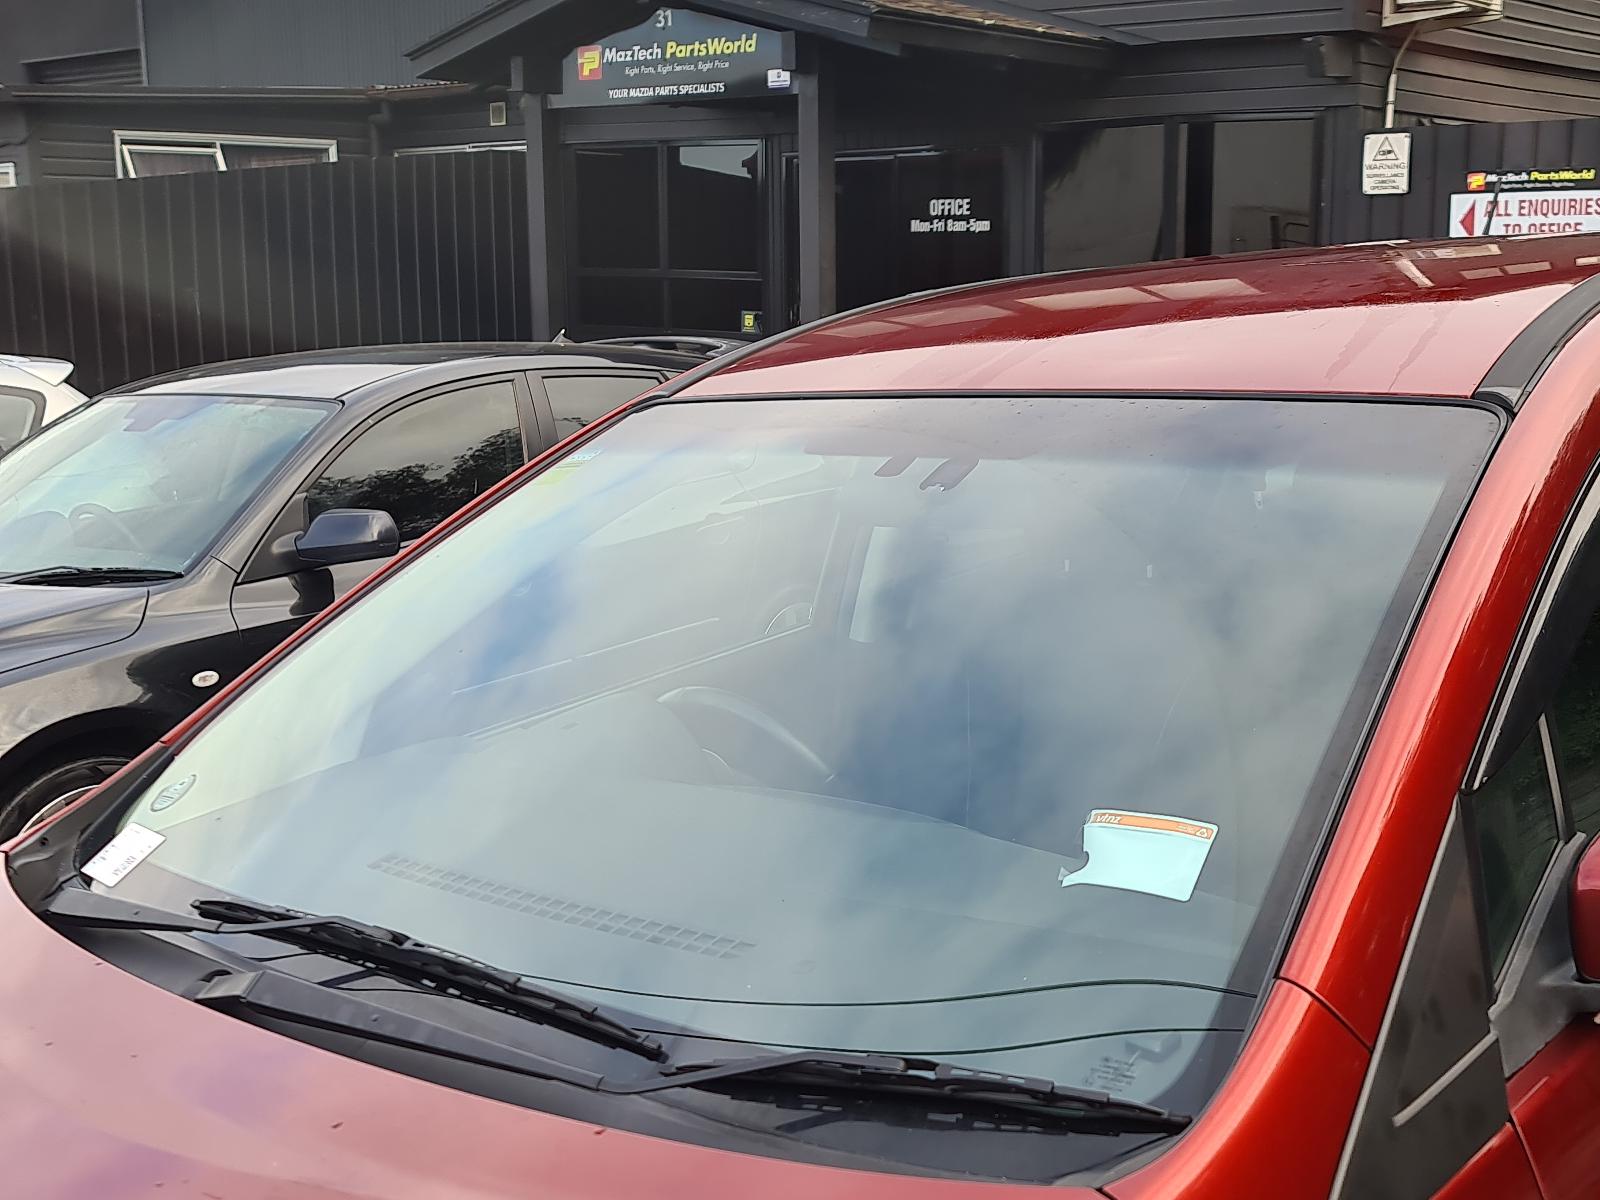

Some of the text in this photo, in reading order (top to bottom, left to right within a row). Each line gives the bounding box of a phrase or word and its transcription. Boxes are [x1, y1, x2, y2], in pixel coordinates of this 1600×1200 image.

[655, 9, 673, 28] 31
[603, 33, 758, 63] MazTech PartsWorld
[625, 65, 640, 76] Right
[657, 63, 673, 74] Right
[674, 62, 696, 72] Service,
[697, 60, 713, 72] Right
[714, 59, 730, 69] Price
[608, 82, 726, 99] YOUR MAZDA PARTS SPECIALISTS
[929, 198, 971, 216] OFFICE
[910, 218, 991, 233] Mon-Fri 8am-5pm
